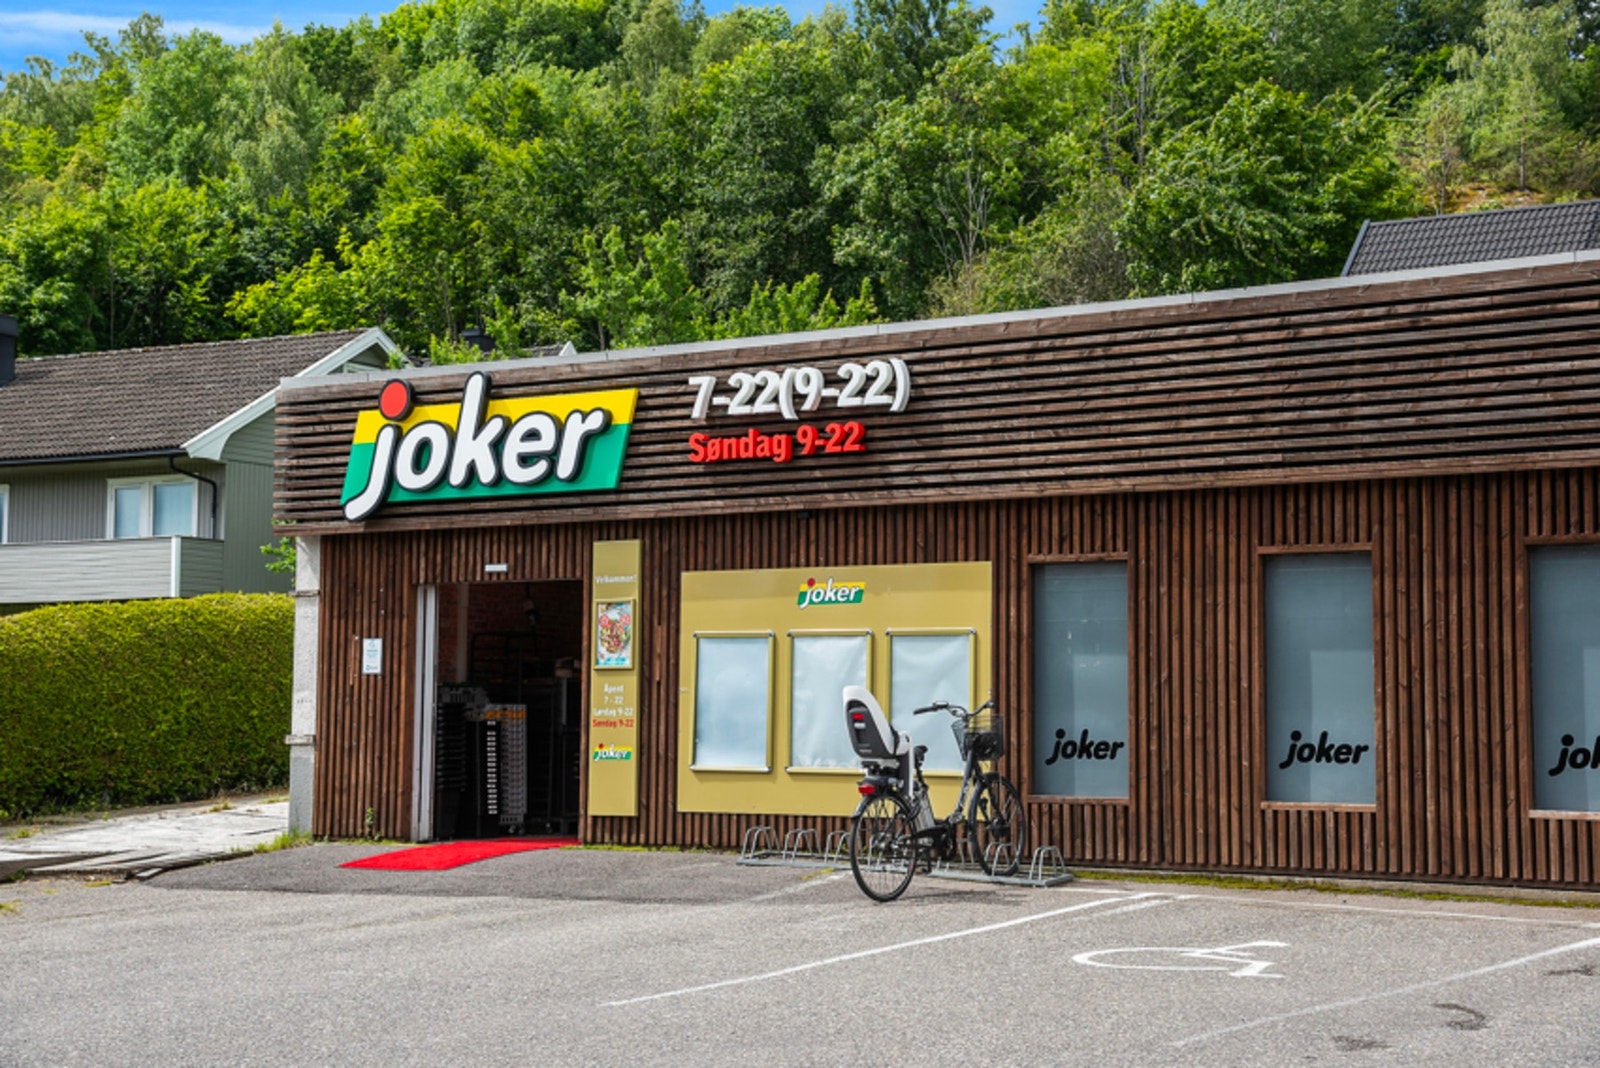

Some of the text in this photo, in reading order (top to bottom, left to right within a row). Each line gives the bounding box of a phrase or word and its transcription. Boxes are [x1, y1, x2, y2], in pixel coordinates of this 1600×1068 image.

[343, 371, 613, 522] joker
[688, 421, 866, 463] Søndag 9-22
[799, 576, 861, 610] joker
[592, 719, 617, 728] Søndag
[594, 743, 630, 761] joker
[1044, 728, 1125, 766] joker
[1279, 730, 1369, 770] joker
